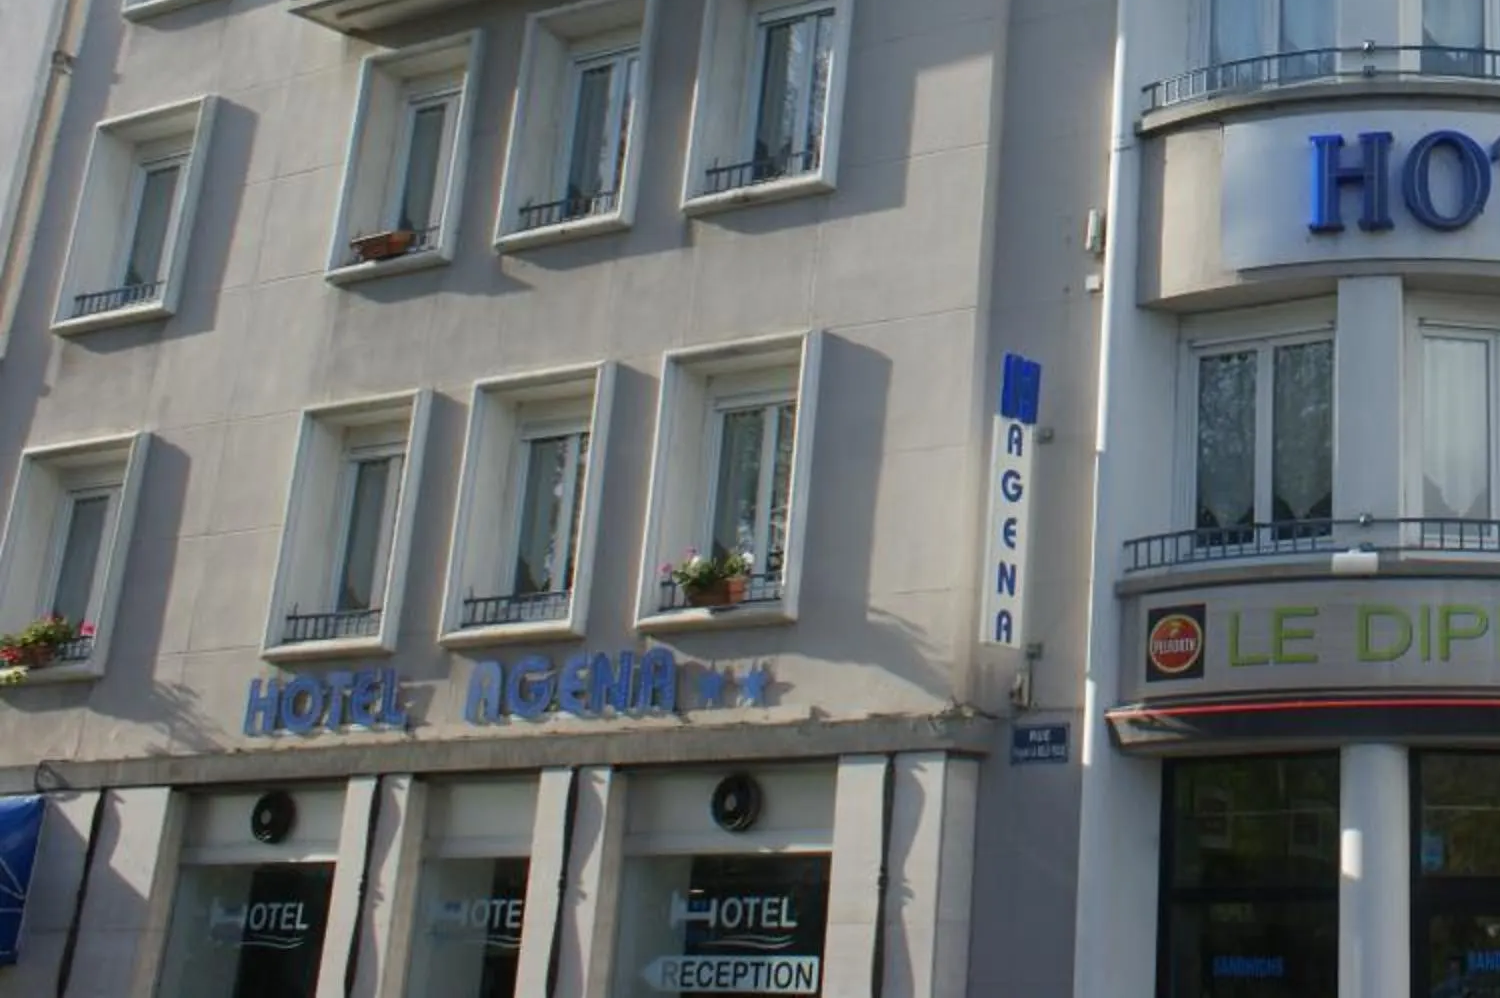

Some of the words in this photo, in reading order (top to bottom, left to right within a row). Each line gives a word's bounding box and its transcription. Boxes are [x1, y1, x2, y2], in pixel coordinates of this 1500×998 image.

[995, 423, 1023, 644] AGENA
[1228, 606, 1320, 667] LE
[243, 666, 409, 737] HOTEL
[464, 648, 676, 726] AGENA
[428, 899, 523, 929] HOTE
[669, 890, 798, 929] HOTEL
[660, 960, 813, 990] RECEPTION
